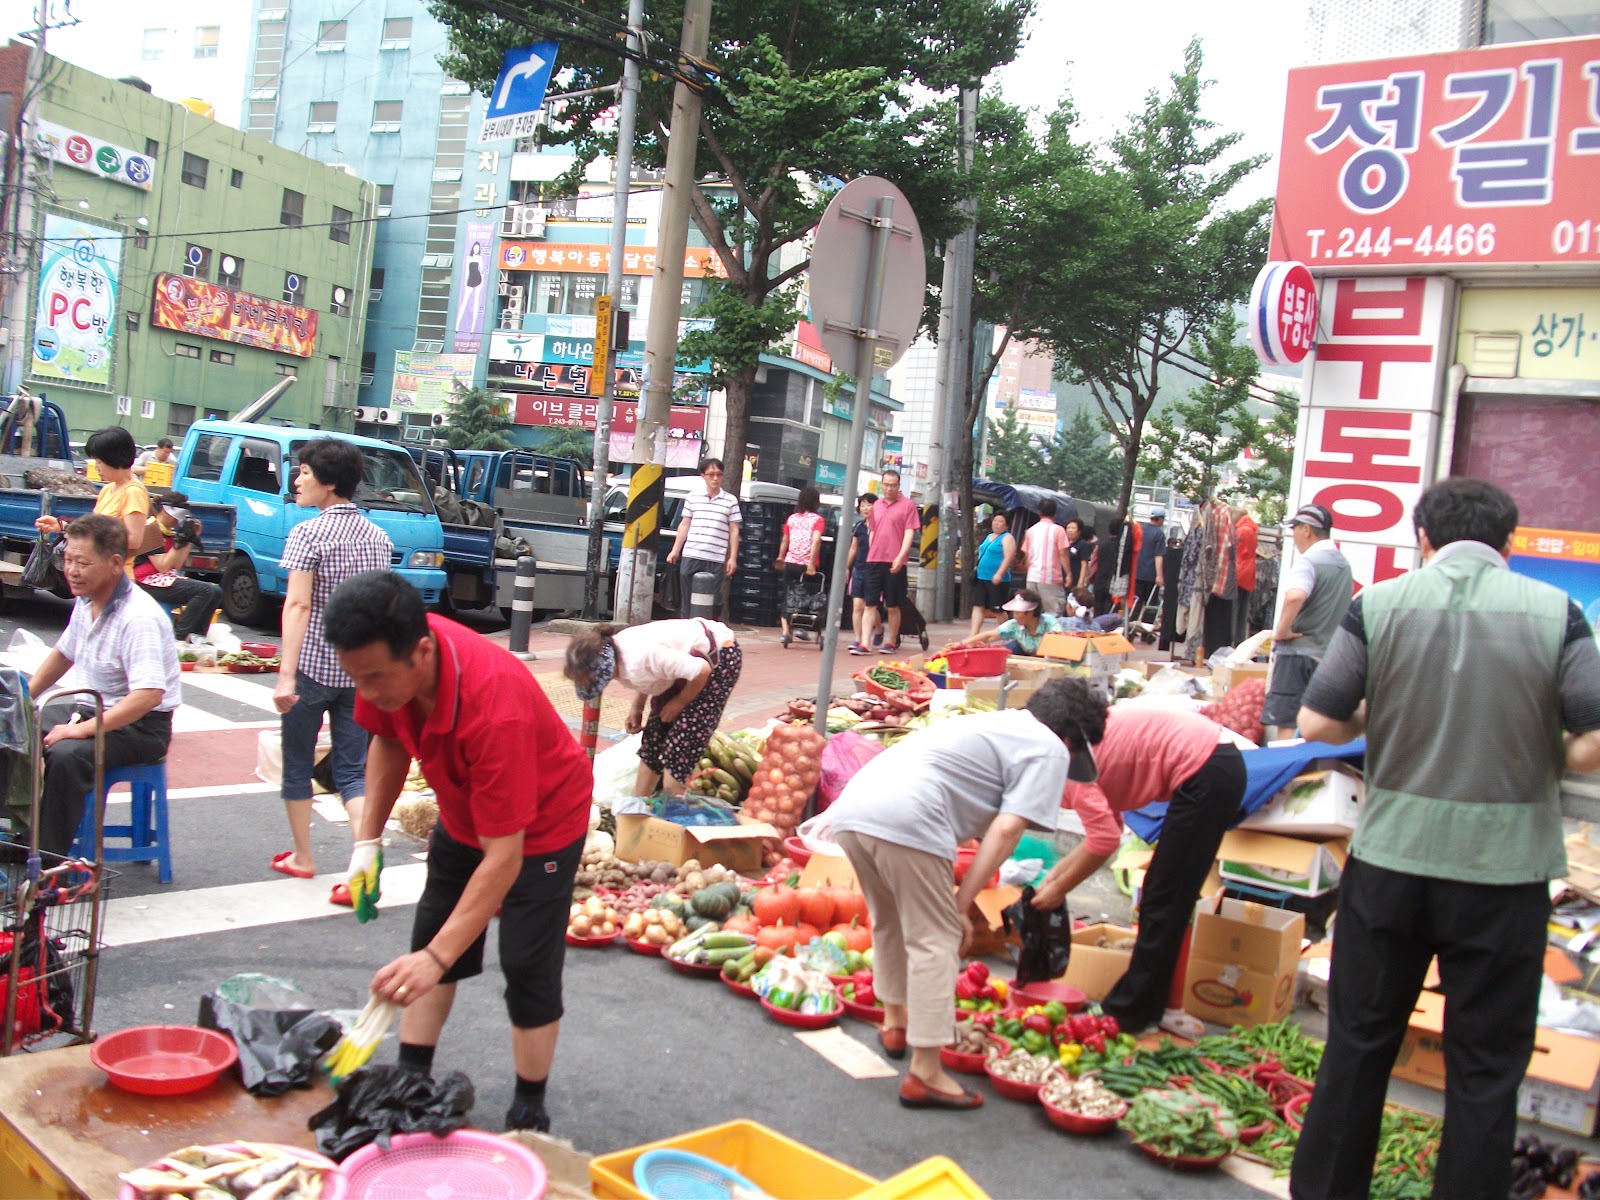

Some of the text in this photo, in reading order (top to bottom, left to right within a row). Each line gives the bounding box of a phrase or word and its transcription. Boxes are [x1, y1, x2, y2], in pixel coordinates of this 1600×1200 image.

[515, 114, 536, 135] 주차장
[67, 136, 148, 181] 당구장
[1306, 222, 1497, 259] T.244-4466
[531, 248, 699, 270] 행복아동달연소
[59, 265, 104, 294] 행복한
[1281, 280, 1314, 349] 부동산
[532, 400, 564, 417] 이브
